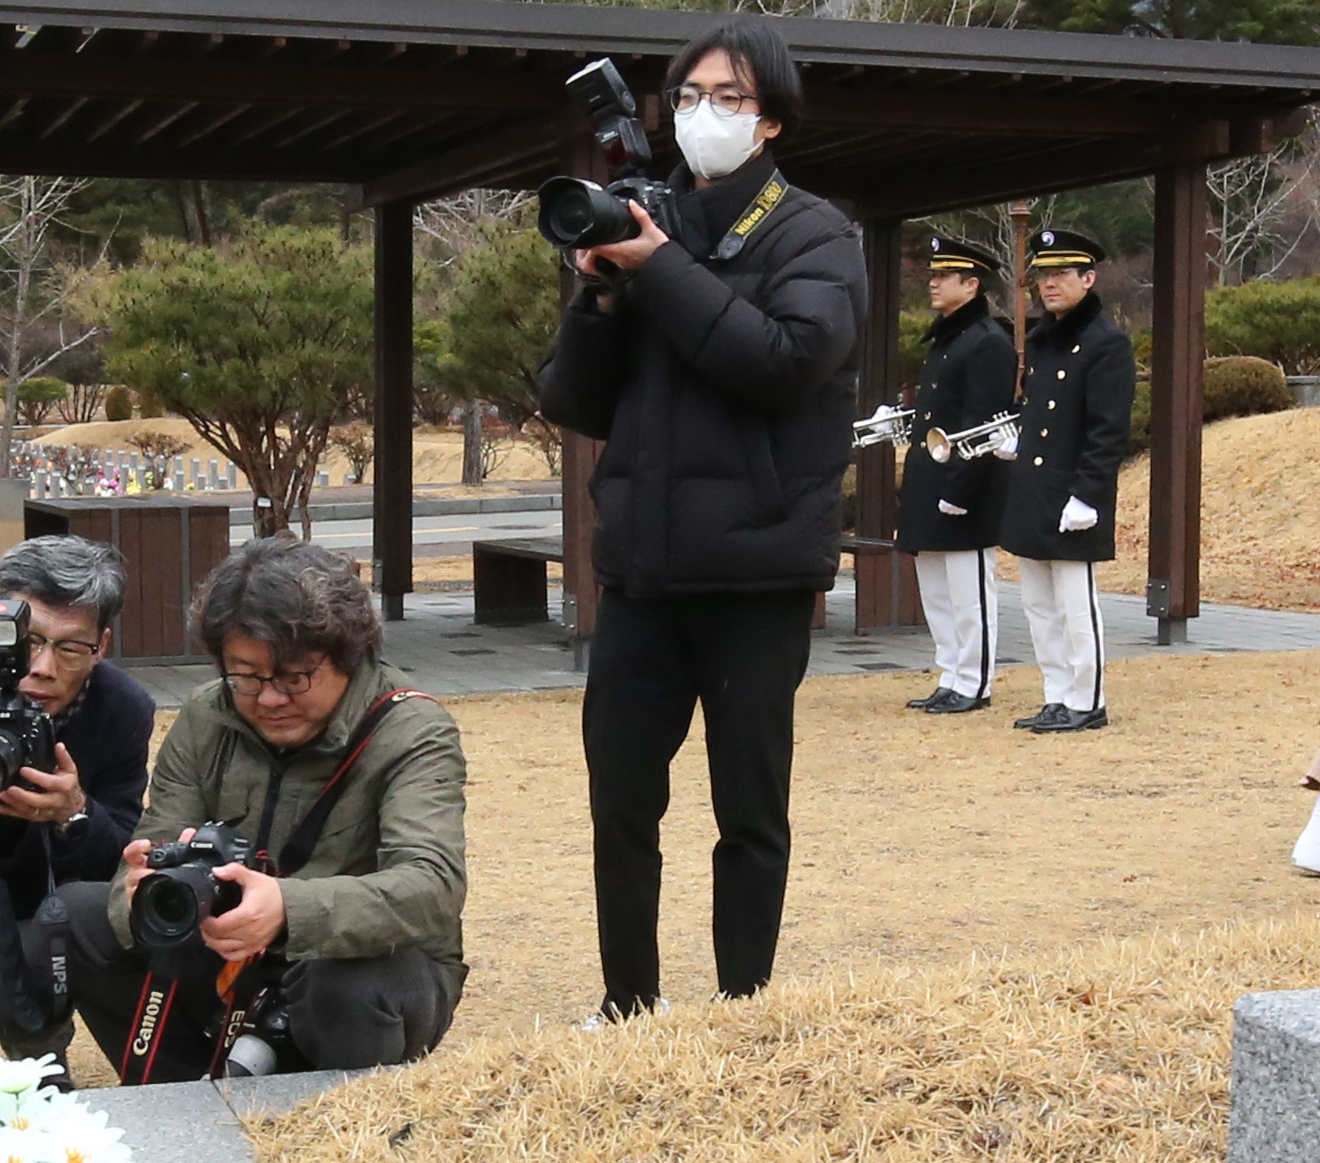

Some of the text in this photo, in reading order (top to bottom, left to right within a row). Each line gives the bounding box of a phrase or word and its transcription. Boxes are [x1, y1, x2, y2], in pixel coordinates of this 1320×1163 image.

[734, 206, 765, 235] Nikon
[51, 956, 68, 995] NPS
[132, 990, 165, 1056] Canon
